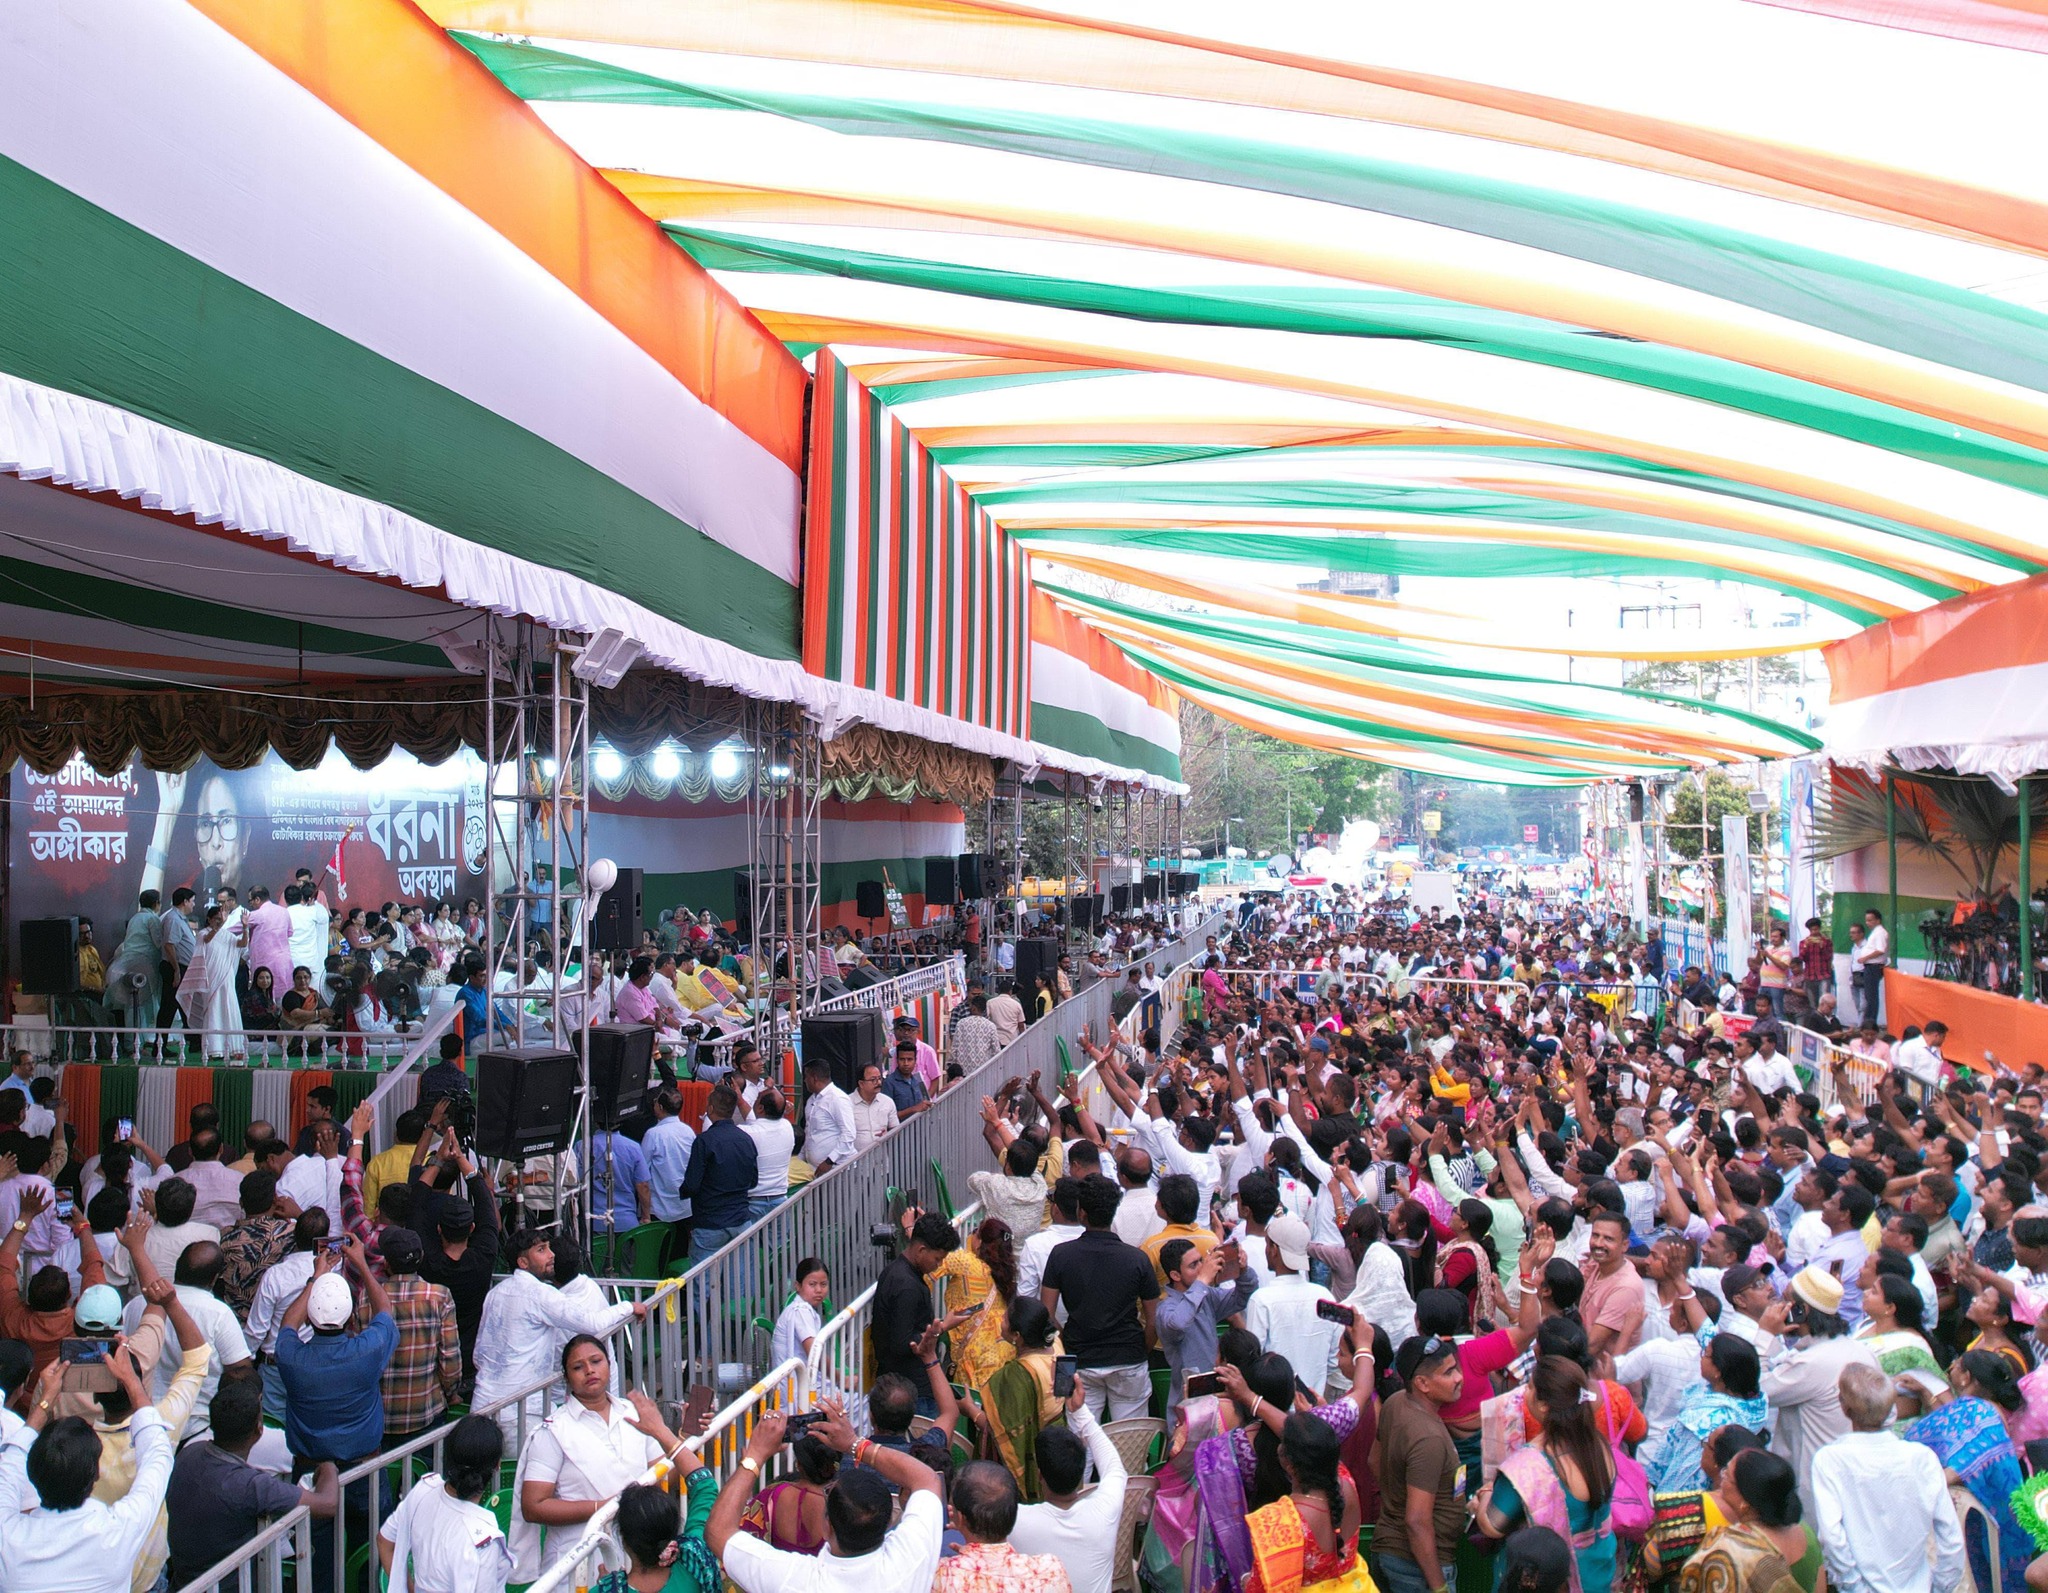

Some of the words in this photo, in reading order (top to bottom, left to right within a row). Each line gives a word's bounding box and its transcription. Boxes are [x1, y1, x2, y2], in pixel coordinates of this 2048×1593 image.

[33, 788, 57, 815] এই
[61, 794, 125, 817] আমাদের
[29, 817, 128, 863] অঙ্গীকার
[398, 865, 457, 900] অবস্থান
